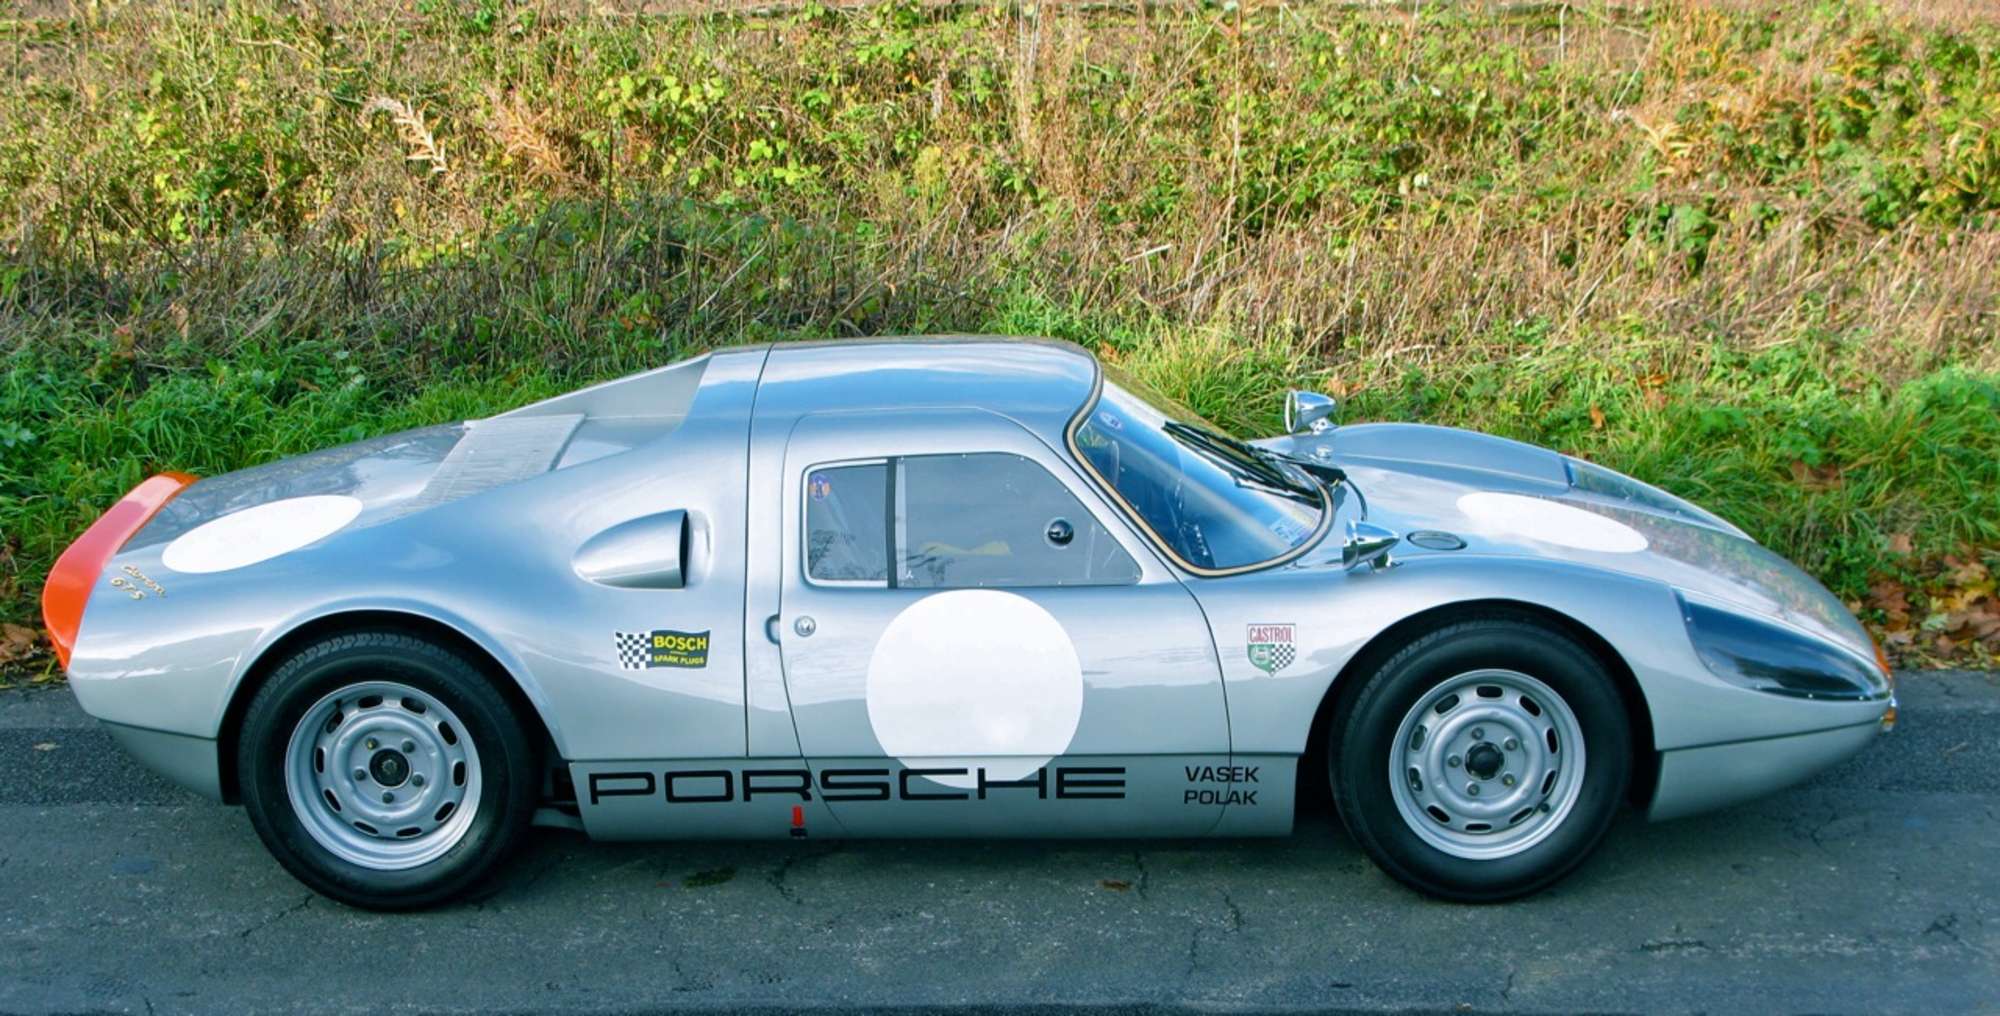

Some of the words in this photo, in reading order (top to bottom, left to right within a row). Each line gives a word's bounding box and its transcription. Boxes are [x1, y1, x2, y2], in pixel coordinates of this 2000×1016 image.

[1249, 627, 1293, 643] CASTROL
[653, 636, 707, 651] BOSCH
[653, 655, 679, 664] SPARK
[680, 656, 705, 665] PLUGS
[1185, 766, 1260, 783] VASEK
[589, 767, 1126, 805] PORSCHE
[1183, 789, 1258, 805] POLAK
